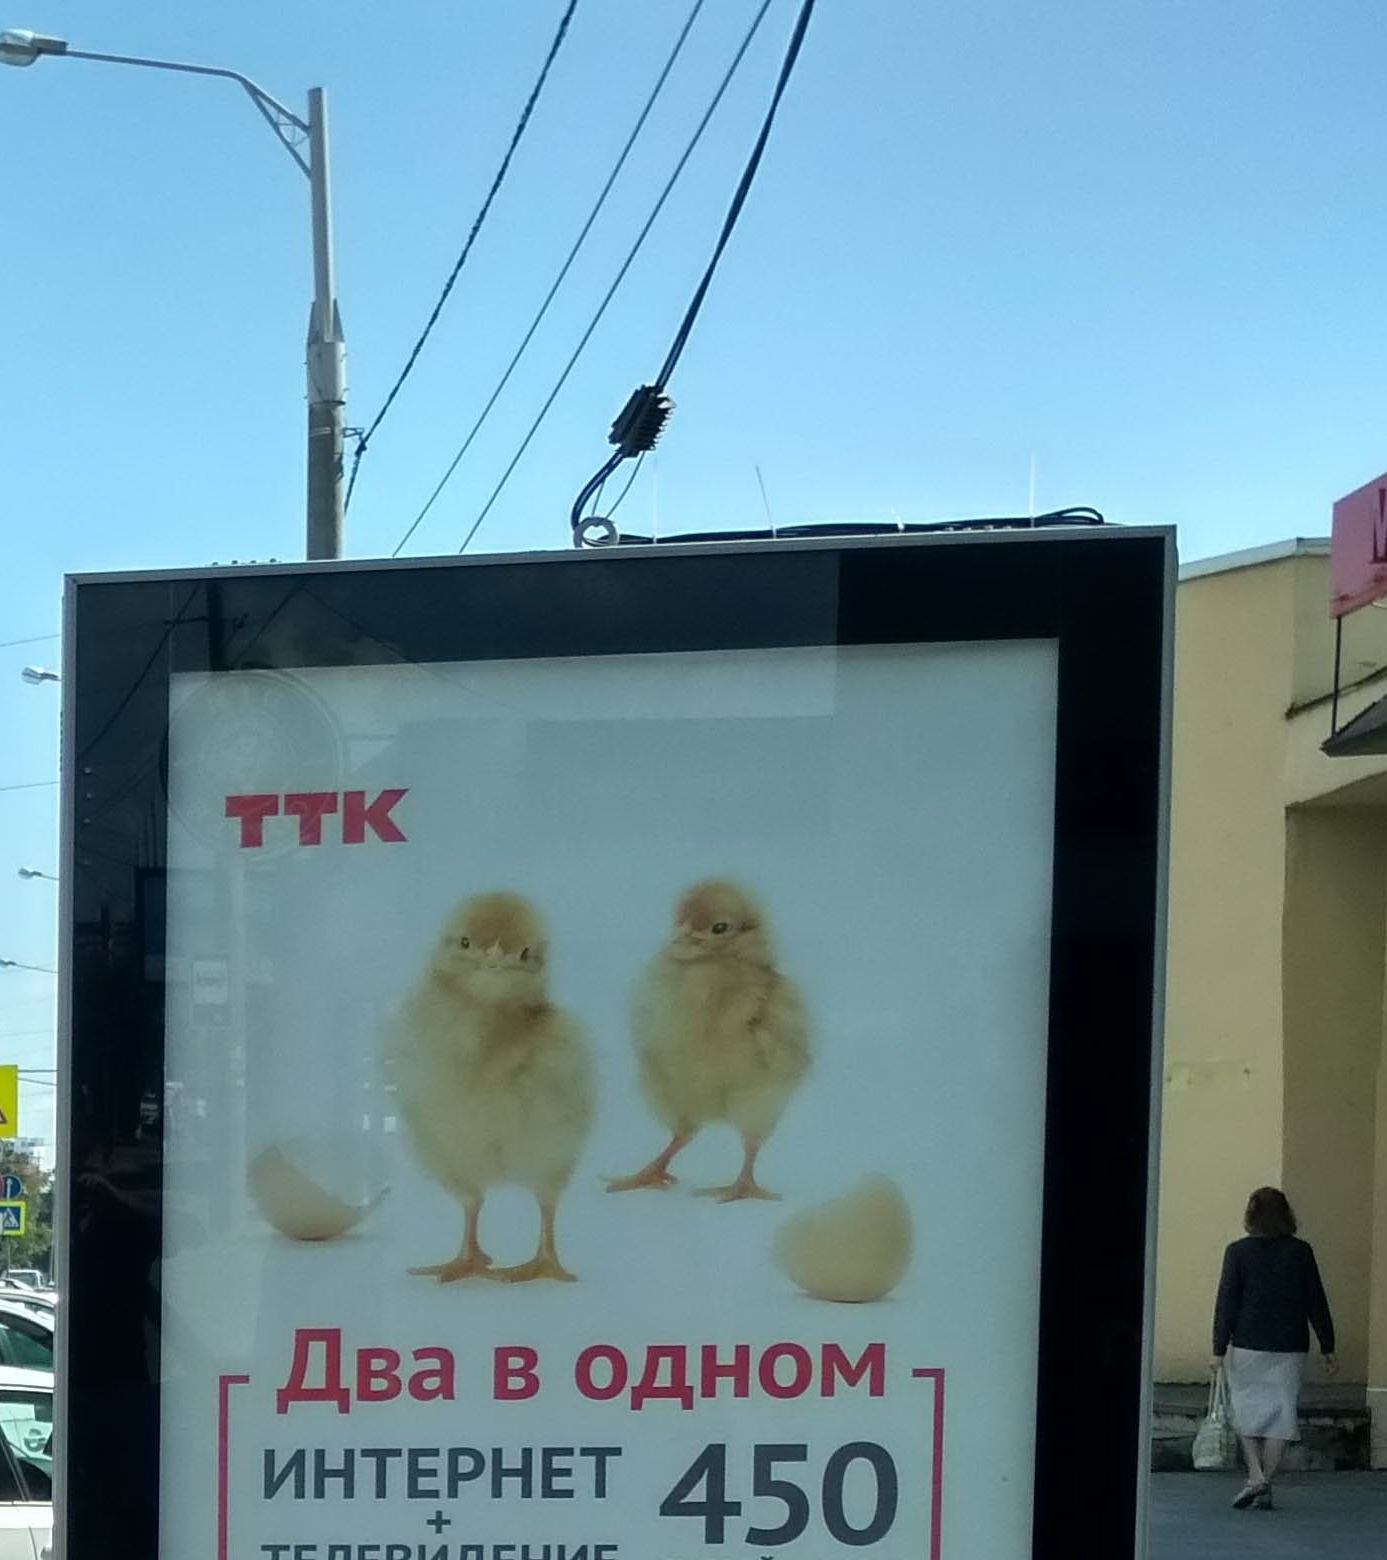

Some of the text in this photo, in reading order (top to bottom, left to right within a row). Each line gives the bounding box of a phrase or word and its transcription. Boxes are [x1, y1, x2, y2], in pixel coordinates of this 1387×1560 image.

[225, 788, 410, 848] ТТК
[276, 1328, 886, 1414] Два в одном
[262, 1446, 623, 1500] ИНТЕРНЕТ
[659, 1441, 899, 1547] 450
